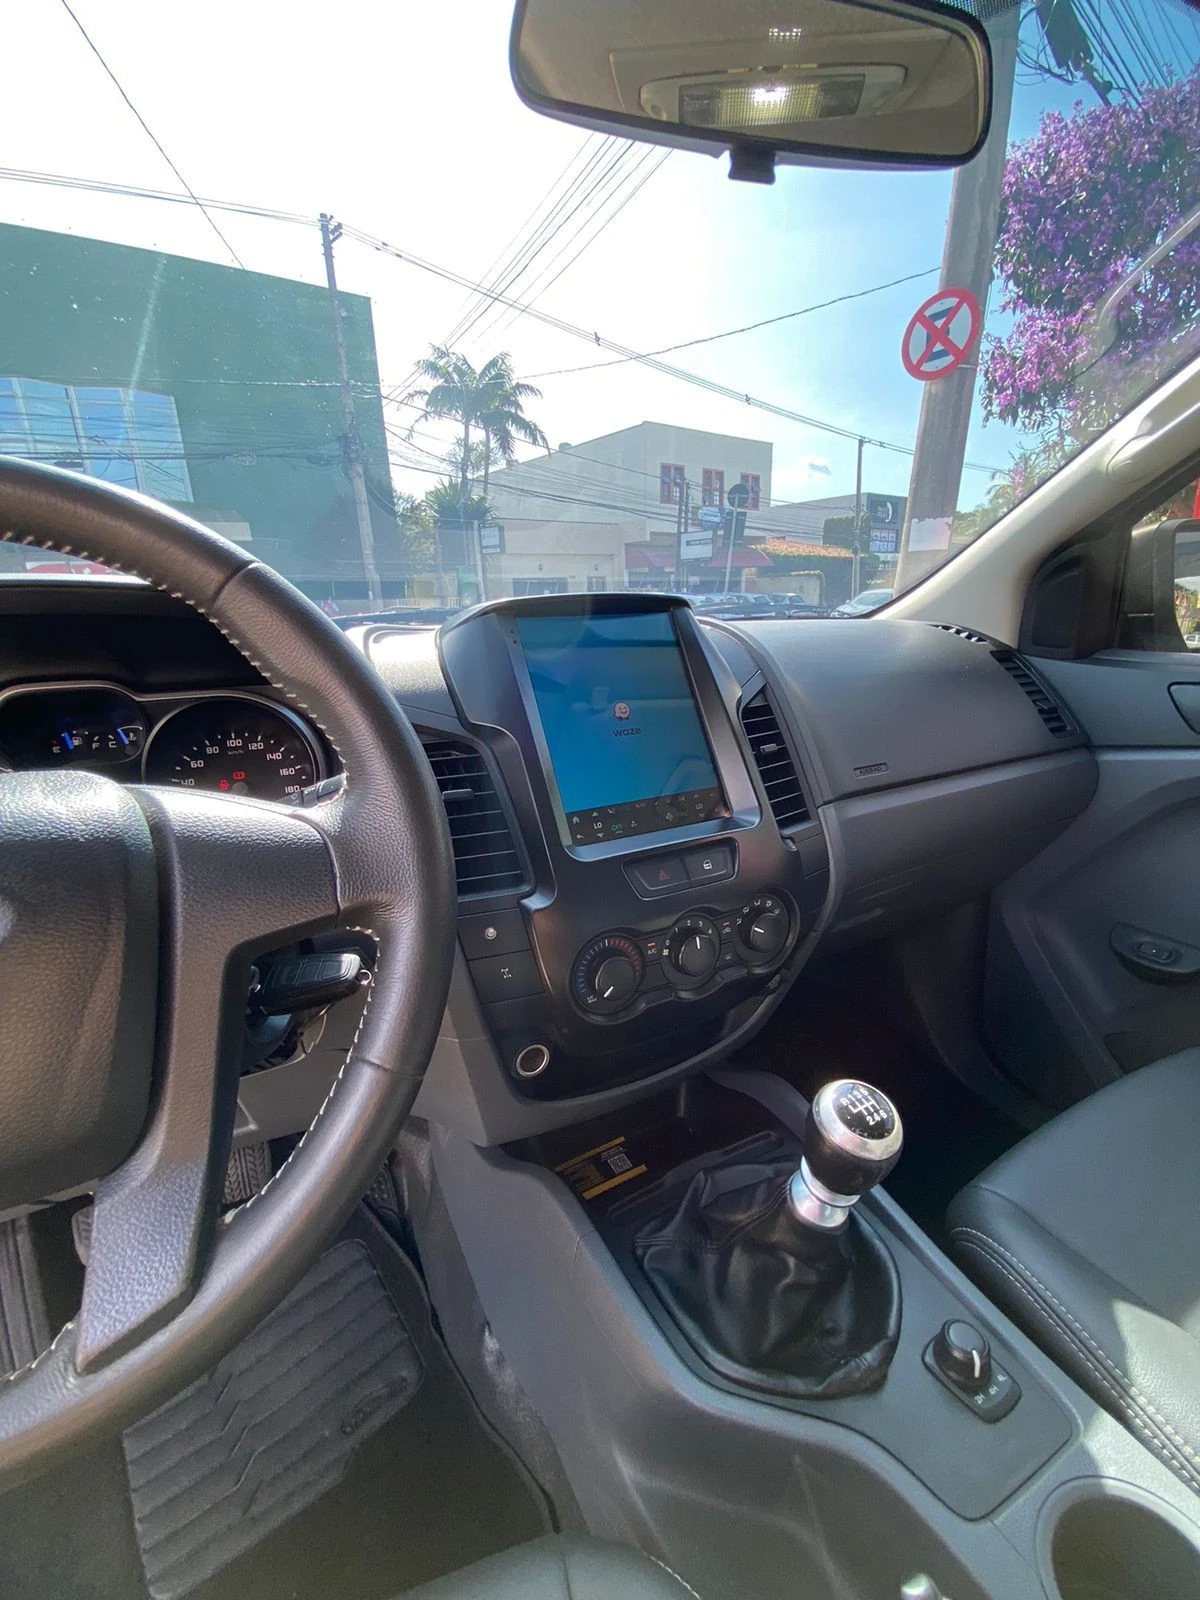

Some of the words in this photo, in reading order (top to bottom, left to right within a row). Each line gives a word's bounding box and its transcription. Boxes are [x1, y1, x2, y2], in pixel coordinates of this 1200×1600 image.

[612, 727, 641, 737] waze
[226, 739, 242, 747] 100
[248, 742, 264, 750] 120
[206, 746, 219, 754] 80
[266, 752, 282, 761] 140
[190, 760, 204, 768] 60
[280, 768, 295, 776] 160
[181, 778, 195, 786] 40
[285, 785, 300, 794] 180
